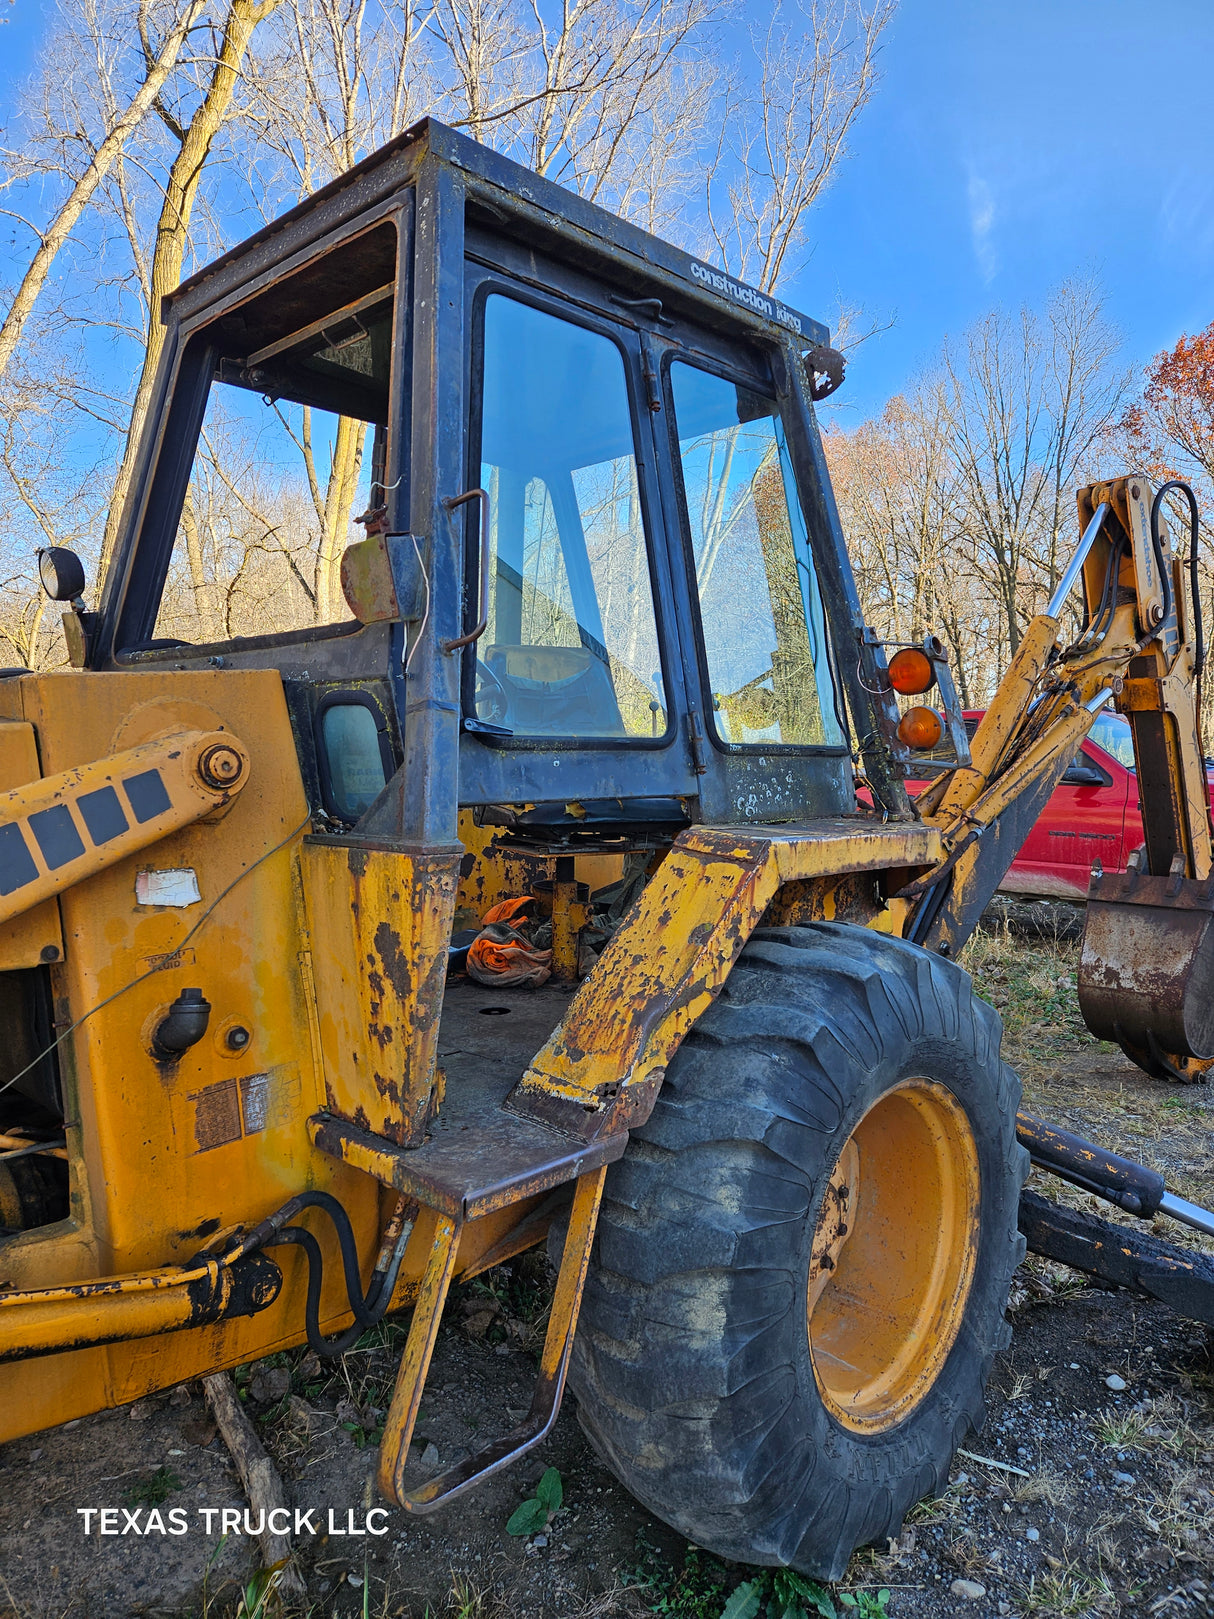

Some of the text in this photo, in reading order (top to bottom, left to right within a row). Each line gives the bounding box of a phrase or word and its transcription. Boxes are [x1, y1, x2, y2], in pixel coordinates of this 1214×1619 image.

[690, 262, 802, 335] construction king
[1138, 501, 1154, 588] extendahoe
